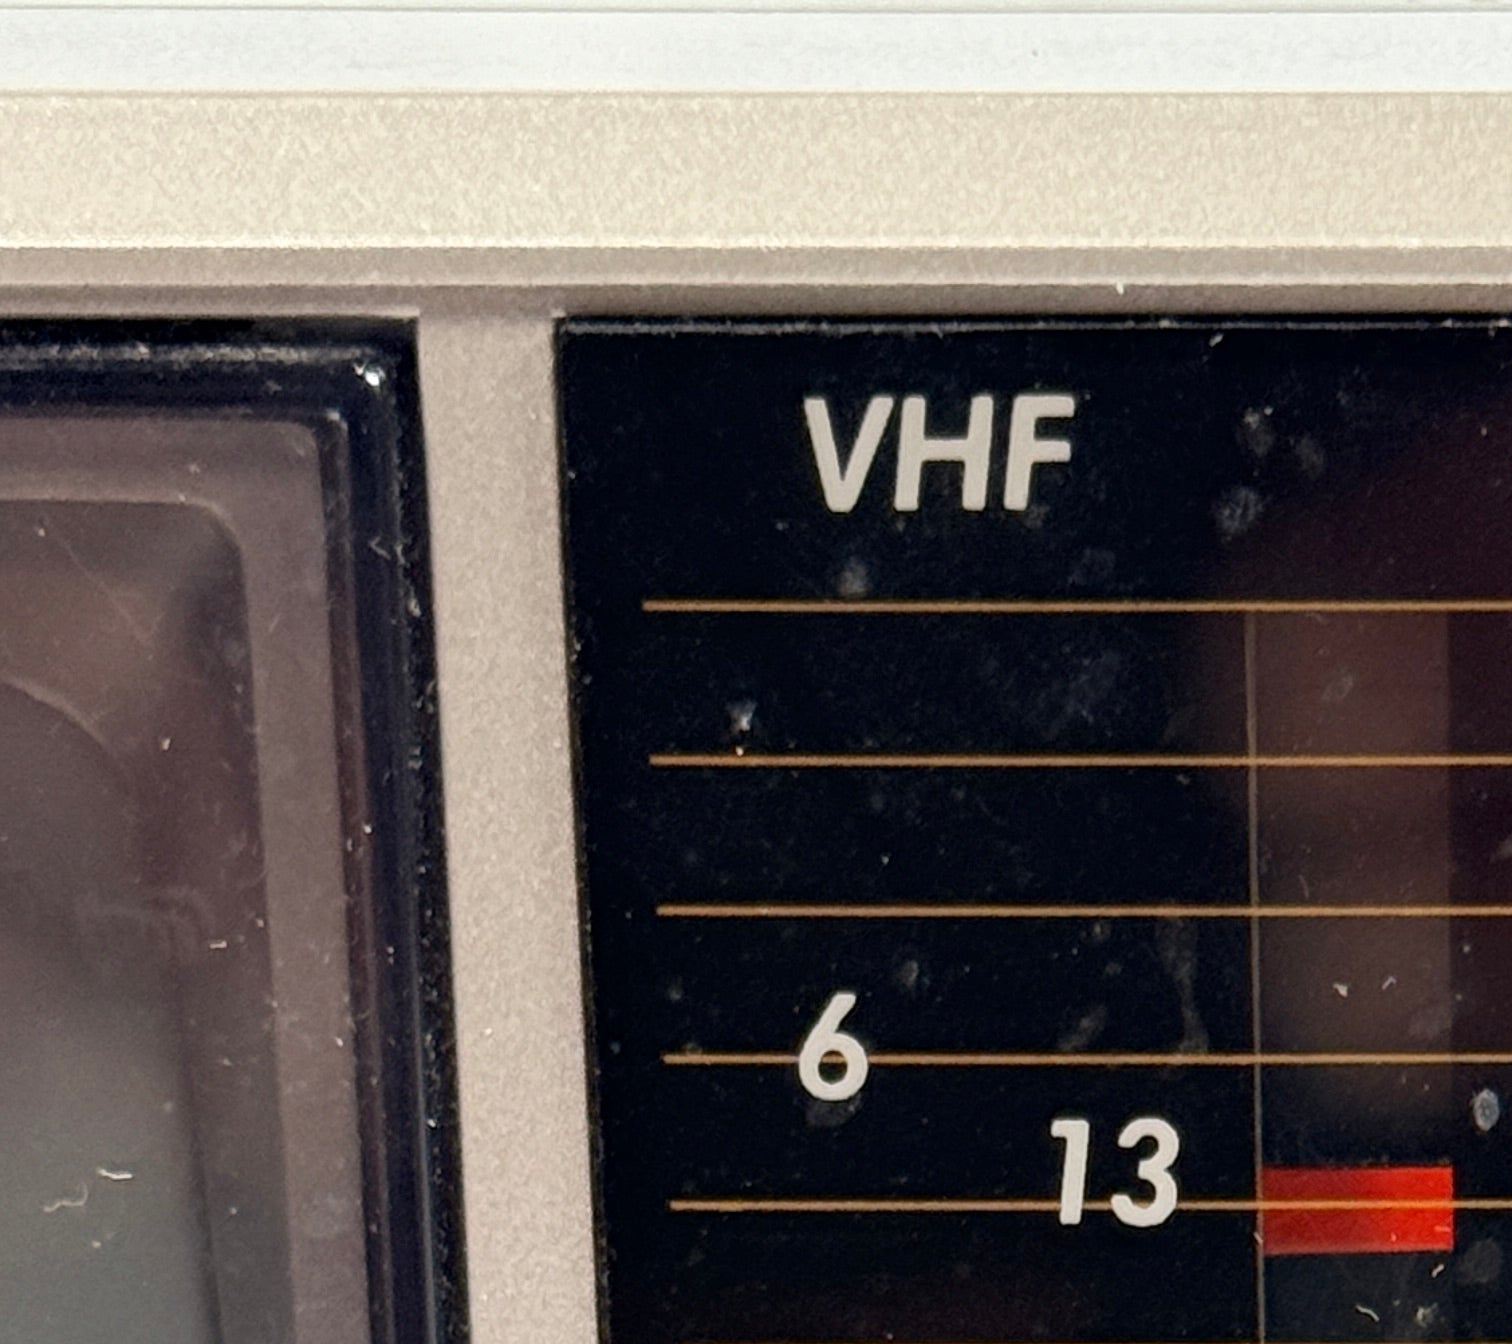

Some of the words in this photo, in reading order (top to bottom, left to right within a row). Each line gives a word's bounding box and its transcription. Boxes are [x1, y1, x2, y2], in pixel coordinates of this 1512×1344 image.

[804, 394, 1075, 512] VHF
[790, 992, 869, 1101] 6
[1050, 1117, 1180, 1227] 13
